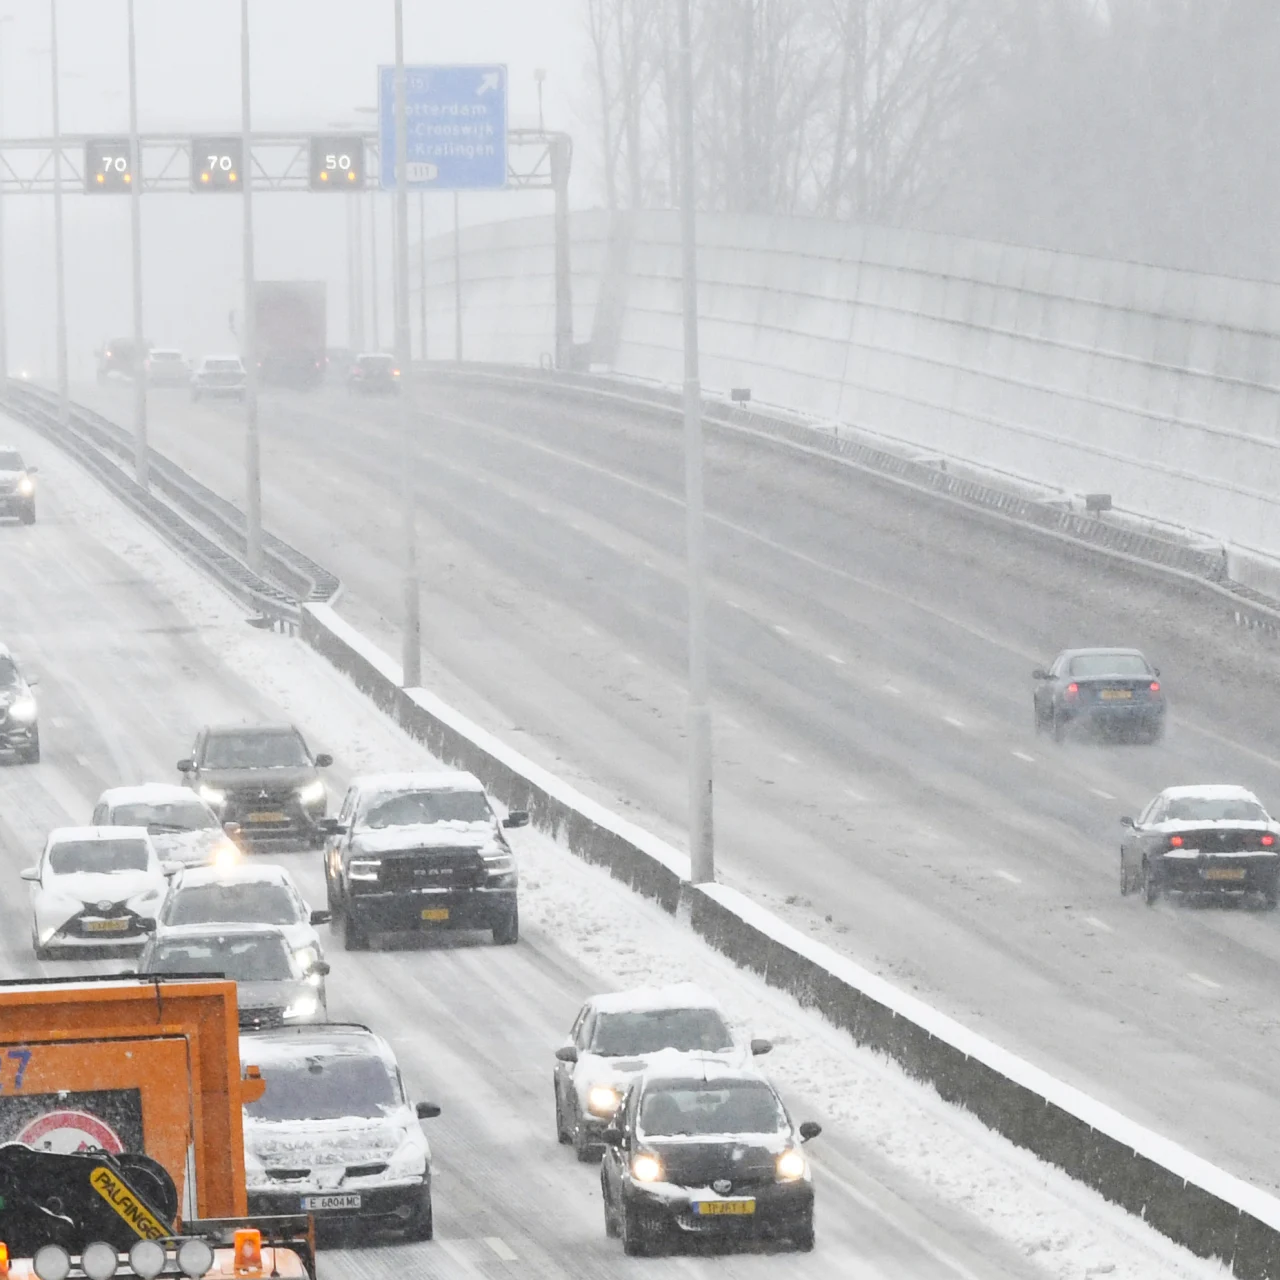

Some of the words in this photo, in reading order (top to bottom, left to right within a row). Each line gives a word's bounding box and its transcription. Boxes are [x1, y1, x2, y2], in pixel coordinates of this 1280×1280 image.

[392, 103, 487, 116] otterdam
[102, 156, 127, 172] 70
[207, 155, 232, 171] 70
[325, 155, 351, 170] 50
[94, 1172, 164, 1240] PALFINGE
